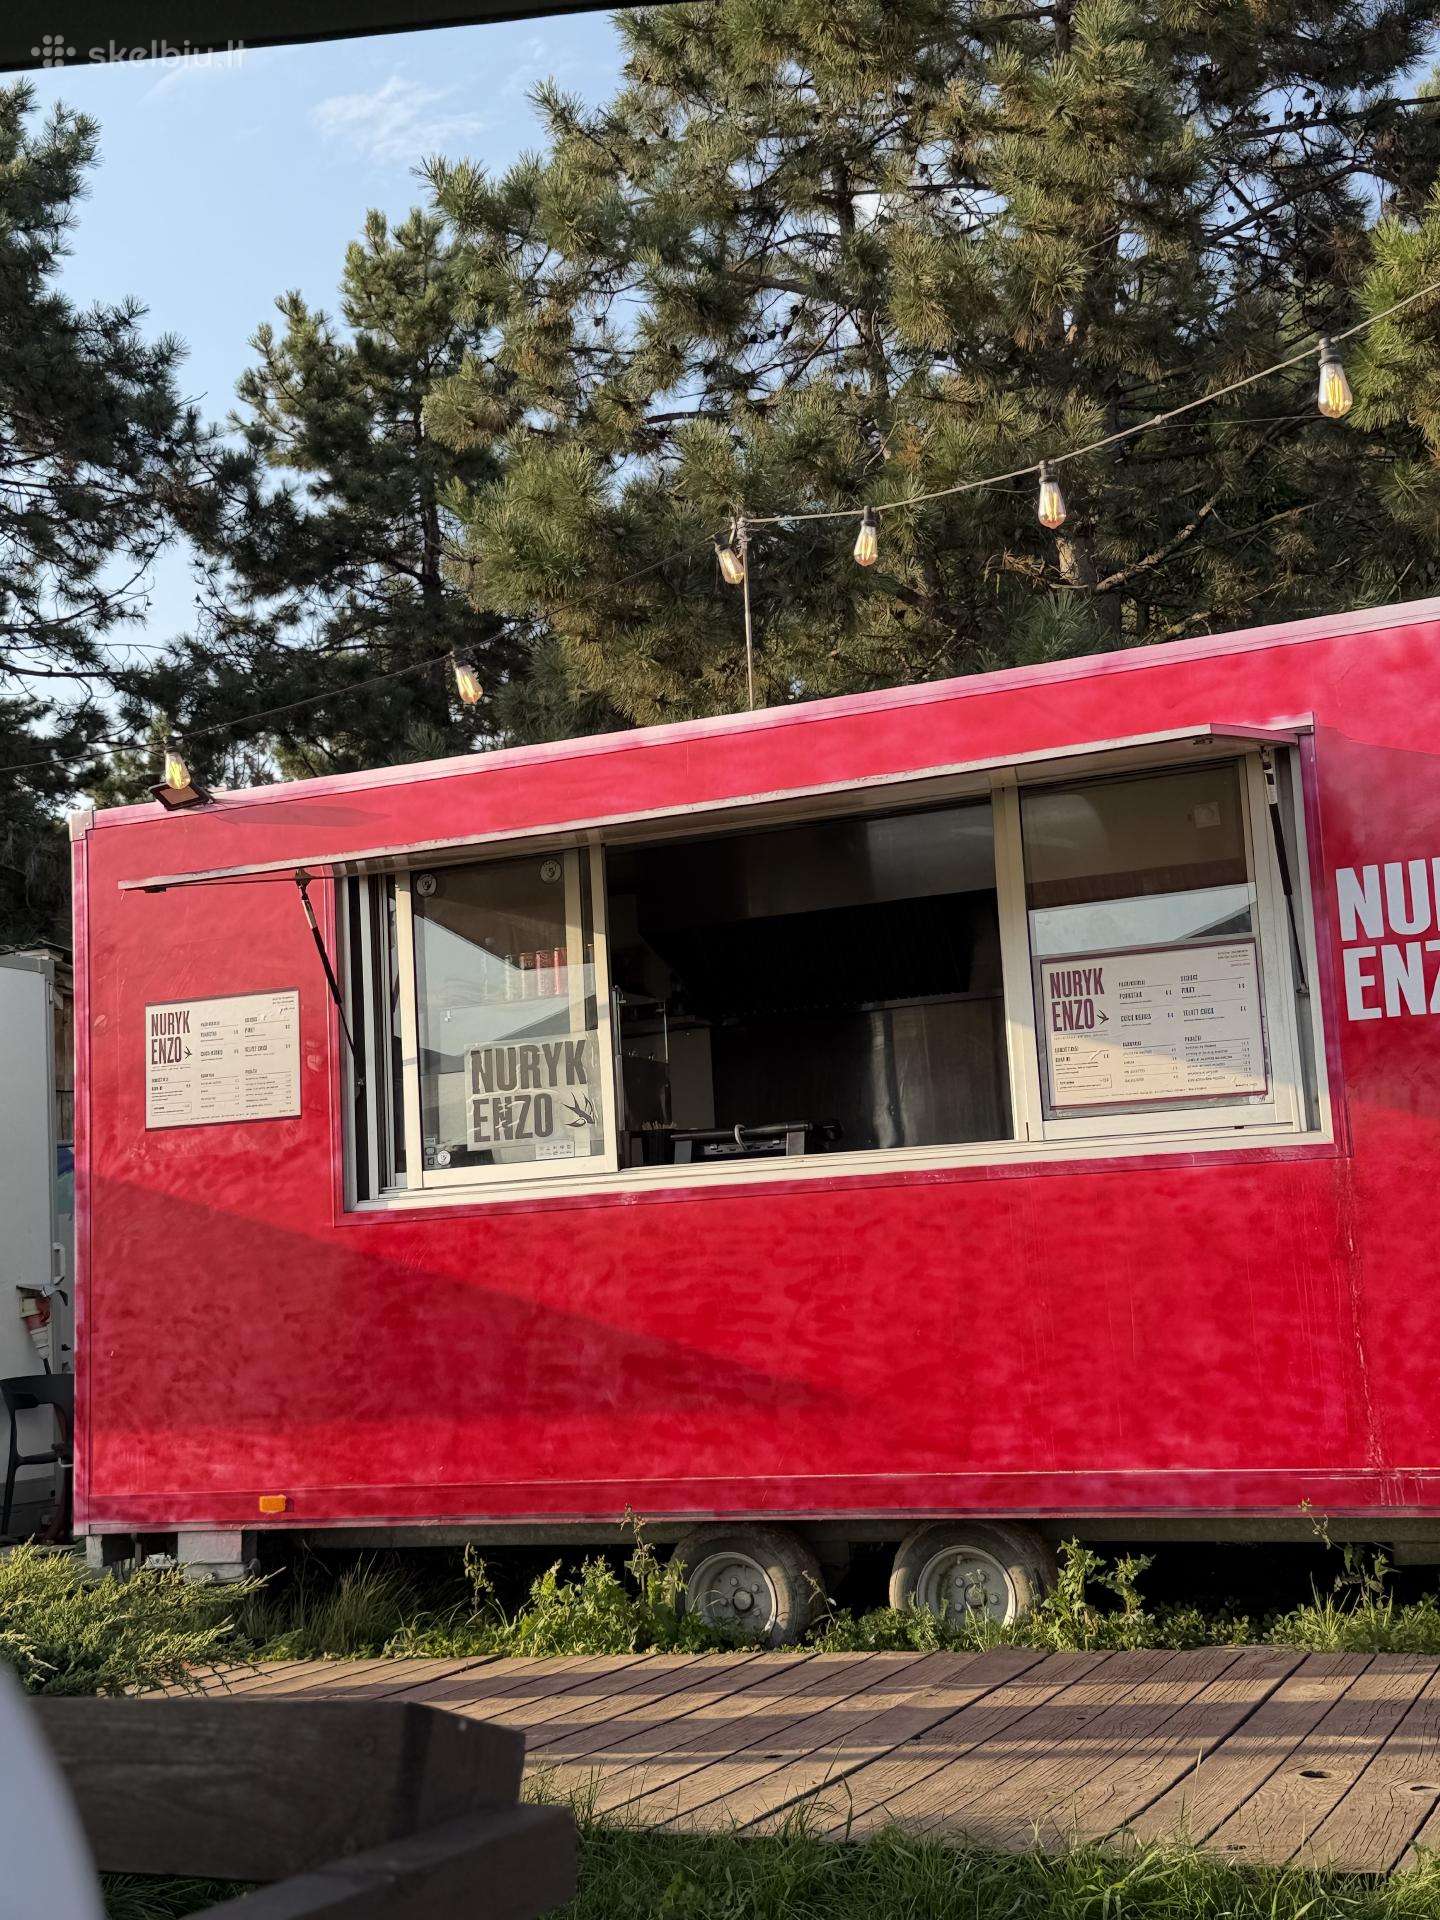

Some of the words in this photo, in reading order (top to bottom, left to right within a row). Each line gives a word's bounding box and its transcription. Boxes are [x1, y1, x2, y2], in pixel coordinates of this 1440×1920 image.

[1335, 857, 1440, 942] NU
[1050, 967, 1105, 999] NURYK
[151, 1010, 191, 1037] NURYK
[1052, 998, 1095, 1032] ENZO
[151, 1036, 182, 1065] ENZO
[471, 1039, 588, 1095] NURYK
[473, 1093, 554, 1143] ENZO
